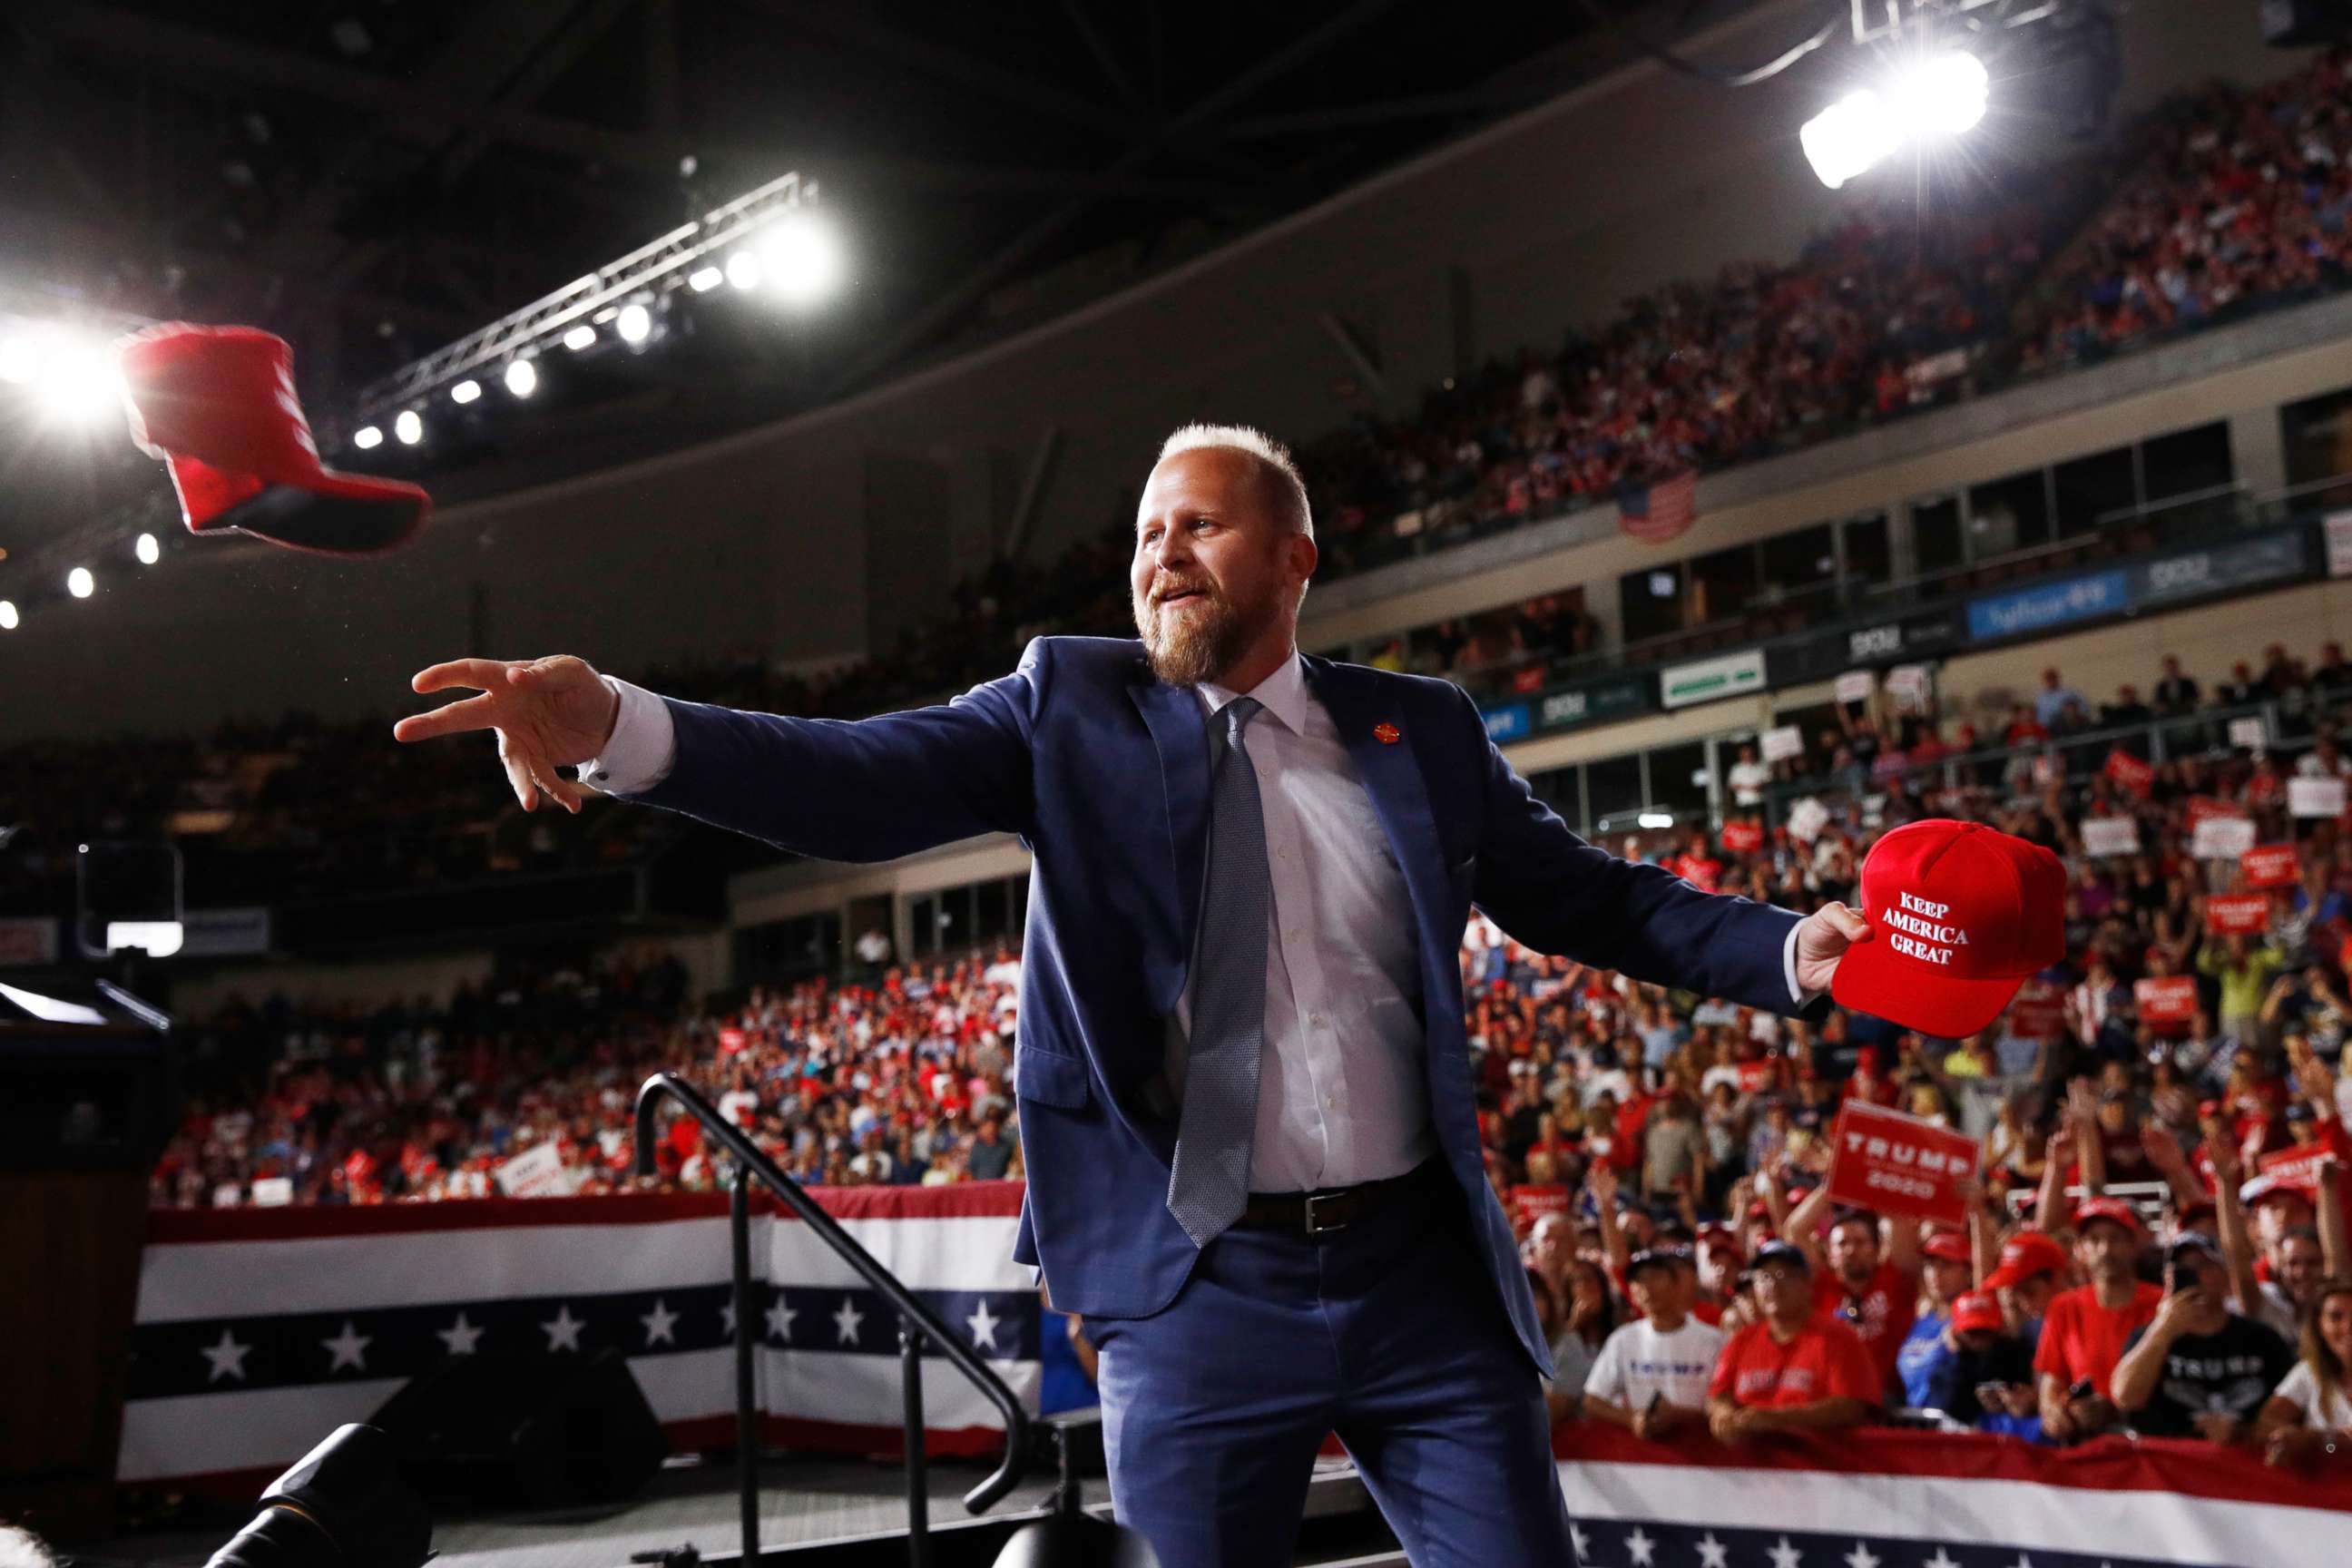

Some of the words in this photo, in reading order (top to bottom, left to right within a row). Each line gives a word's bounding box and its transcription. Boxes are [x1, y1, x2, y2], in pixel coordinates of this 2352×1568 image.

[1899, 891, 1950, 919] KEEP
[1882, 907, 1969, 945] AMERICA
[1890, 933, 1953, 965] GREAT
[1846, 1132, 1970, 1176] TRUMP
[1867, 1168, 1936, 1200] 2020
[2169, 1354, 2262, 1380] TRUMP
